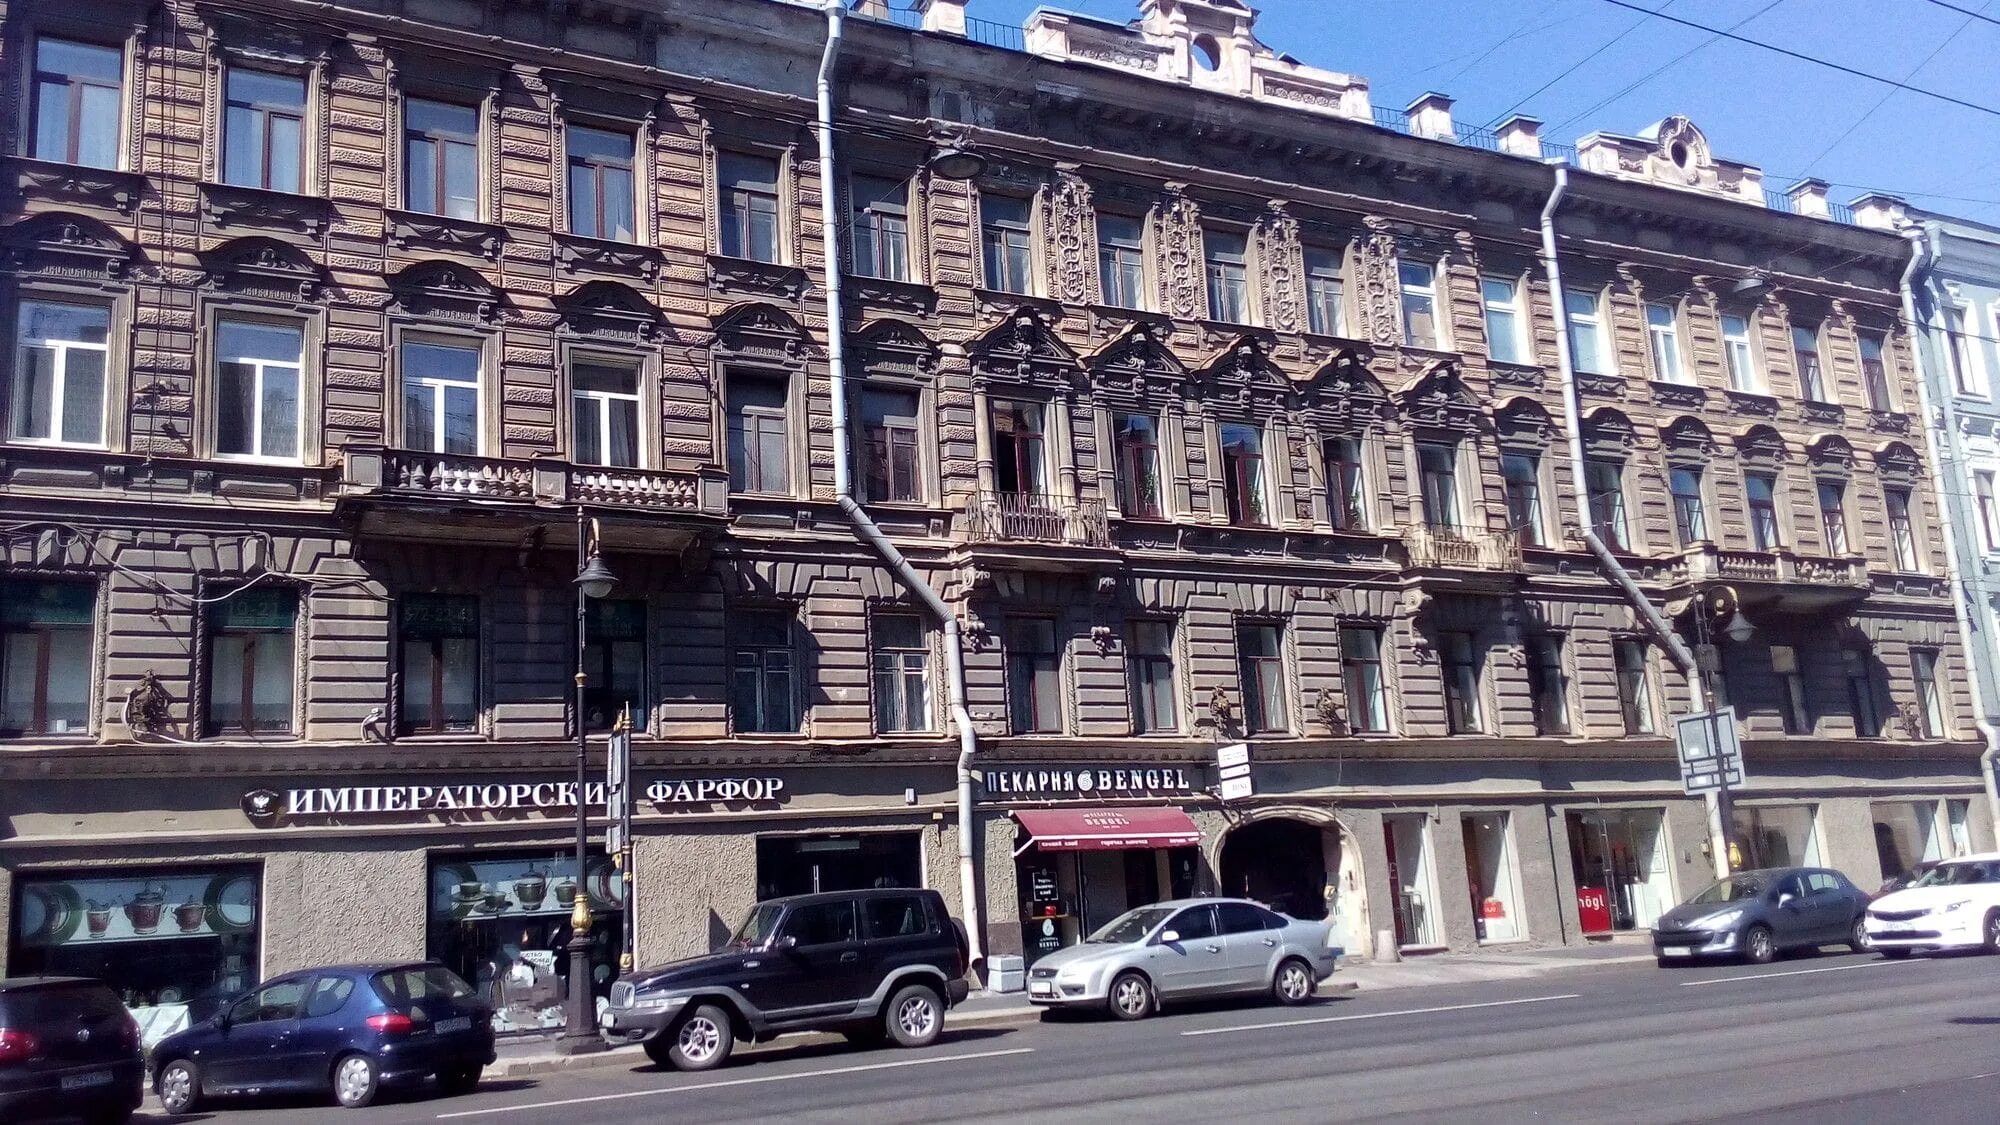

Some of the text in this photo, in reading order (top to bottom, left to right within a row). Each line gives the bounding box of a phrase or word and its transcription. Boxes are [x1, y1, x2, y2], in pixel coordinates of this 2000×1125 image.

[286, 777, 784, 814] ИМПЕРАТОРСКИ ФАРФОР
[986, 769, 1190, 793] ПЕКАРНЯ BENGEL
